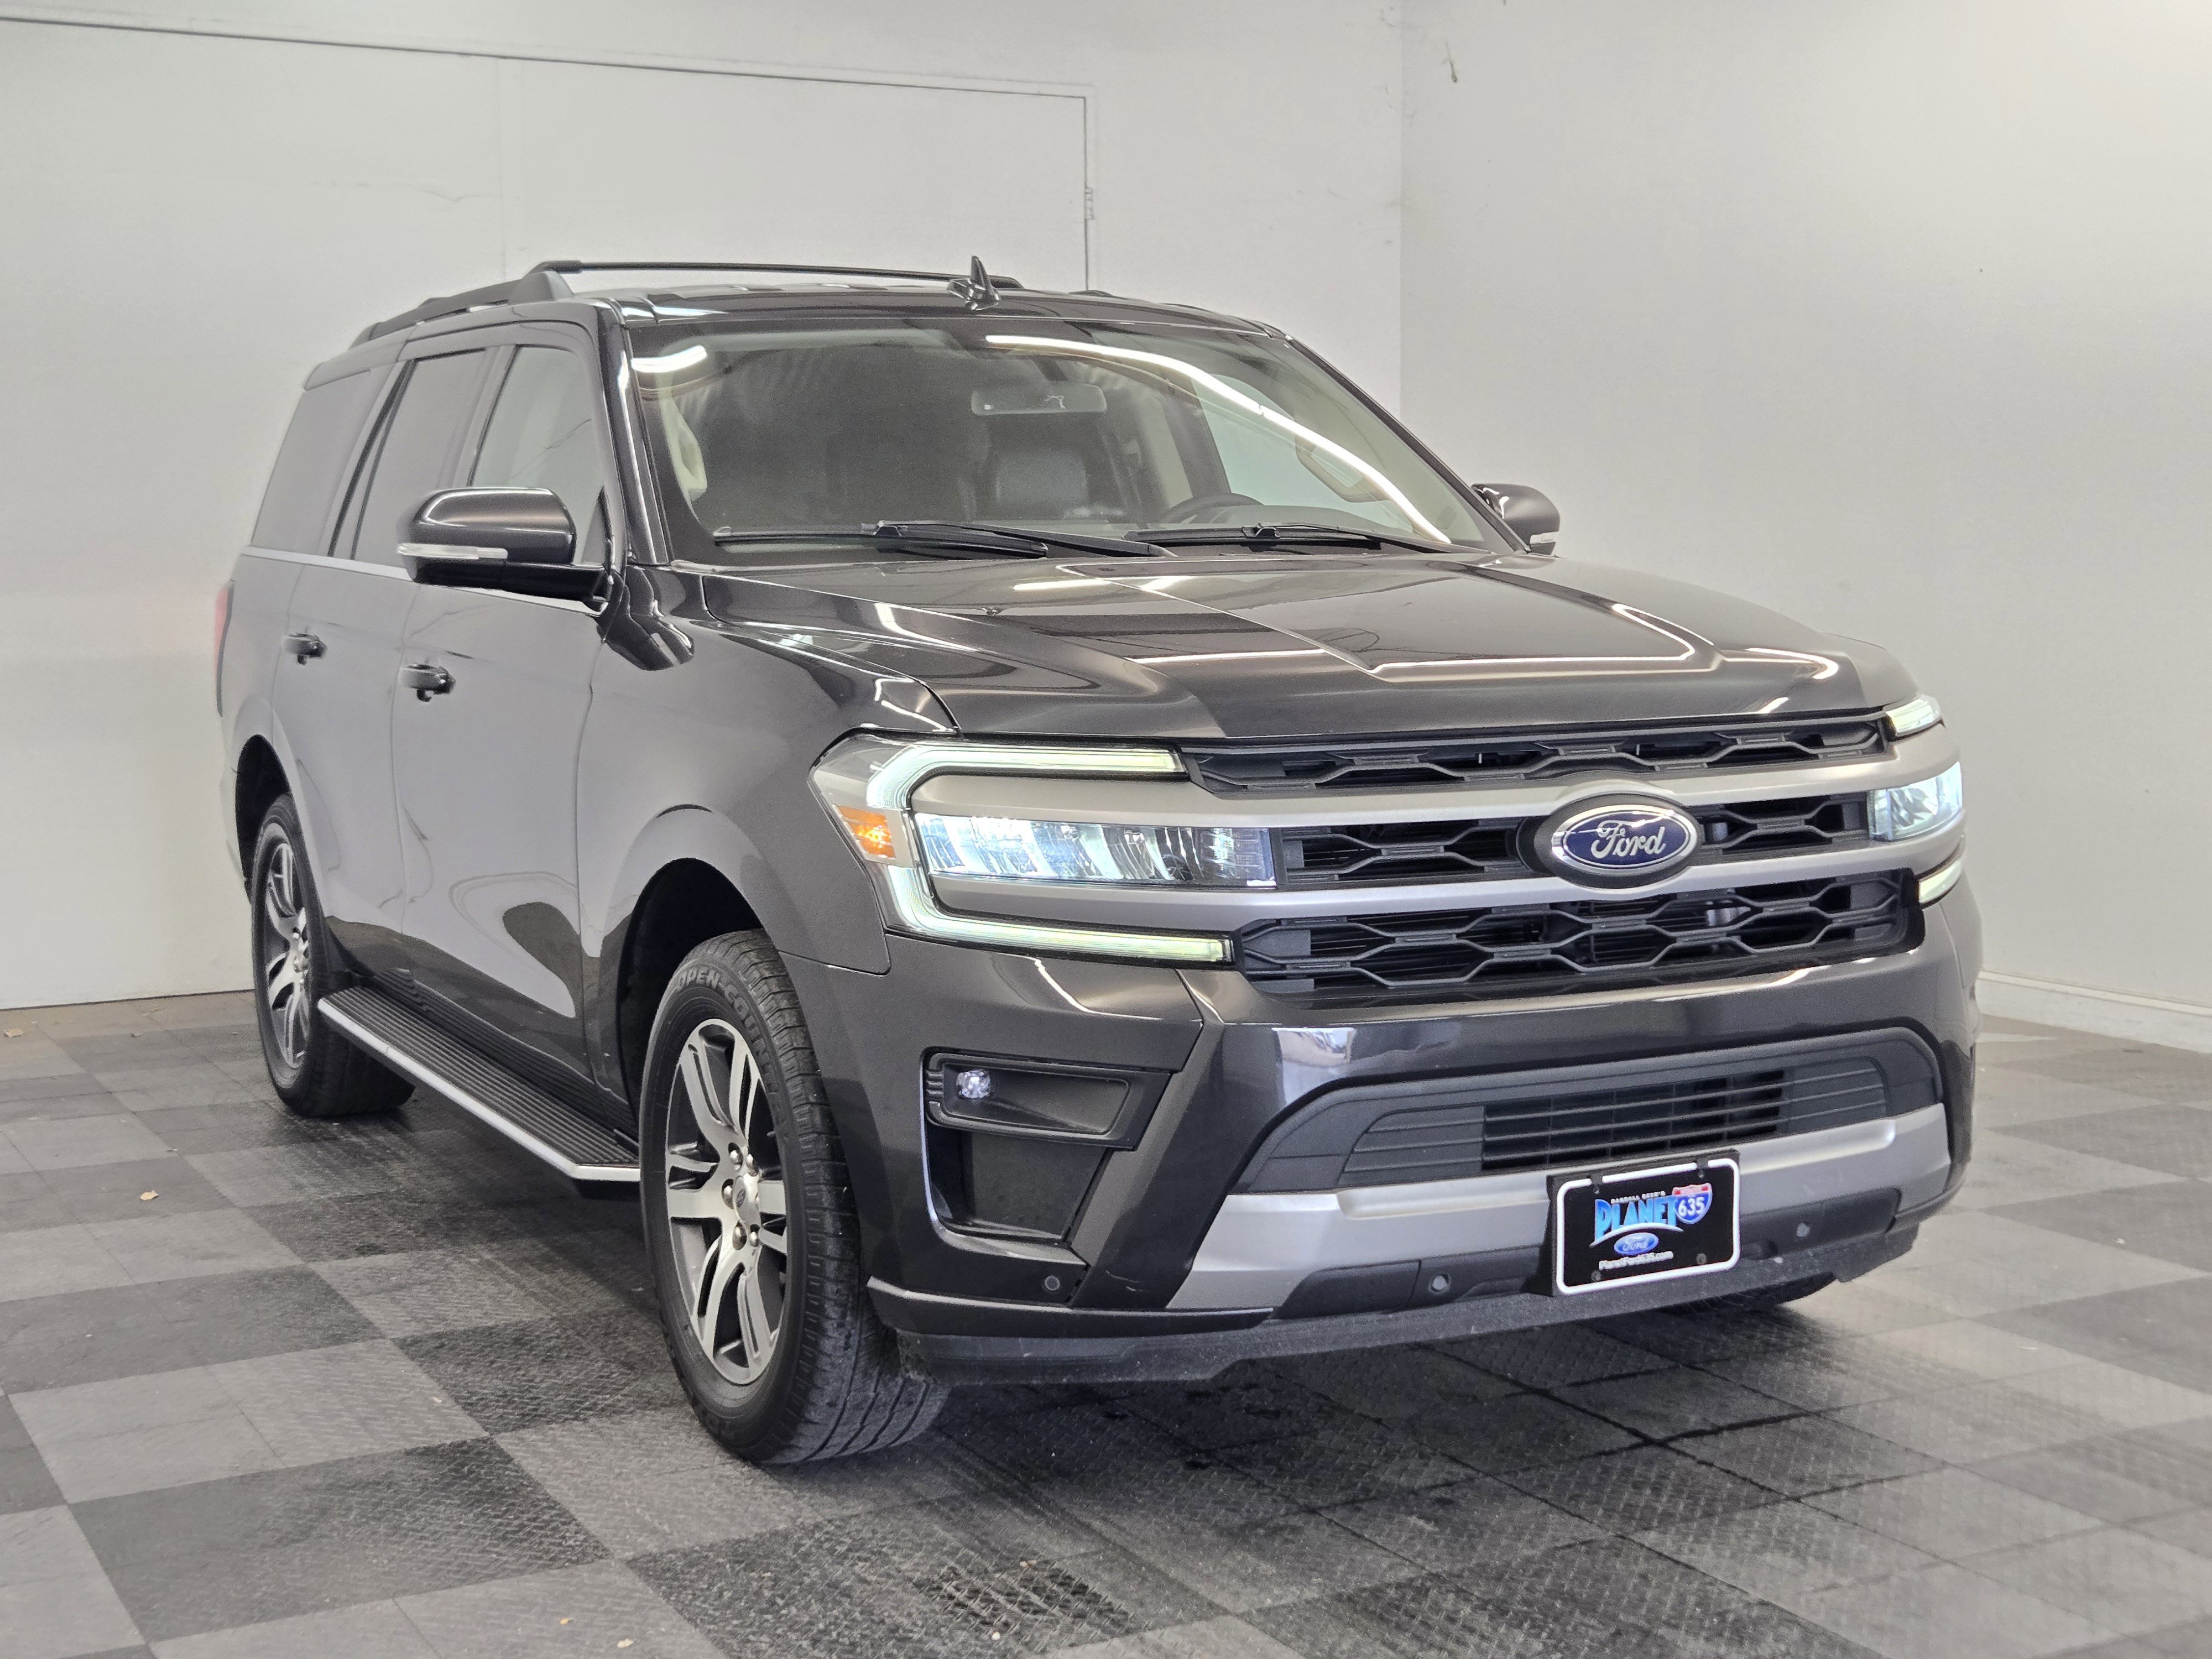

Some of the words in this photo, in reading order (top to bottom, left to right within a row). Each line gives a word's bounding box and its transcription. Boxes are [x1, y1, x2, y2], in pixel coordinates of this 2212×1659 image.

[1591, 820, 1666, 858] Ford
[675, 966, 721, 992] OPEN
[1594, 1196, 1678, 1243] PLANET
[1678, 1197, 1705, 1217] 635
[1622, 1238, 1649, 1251] Ford
